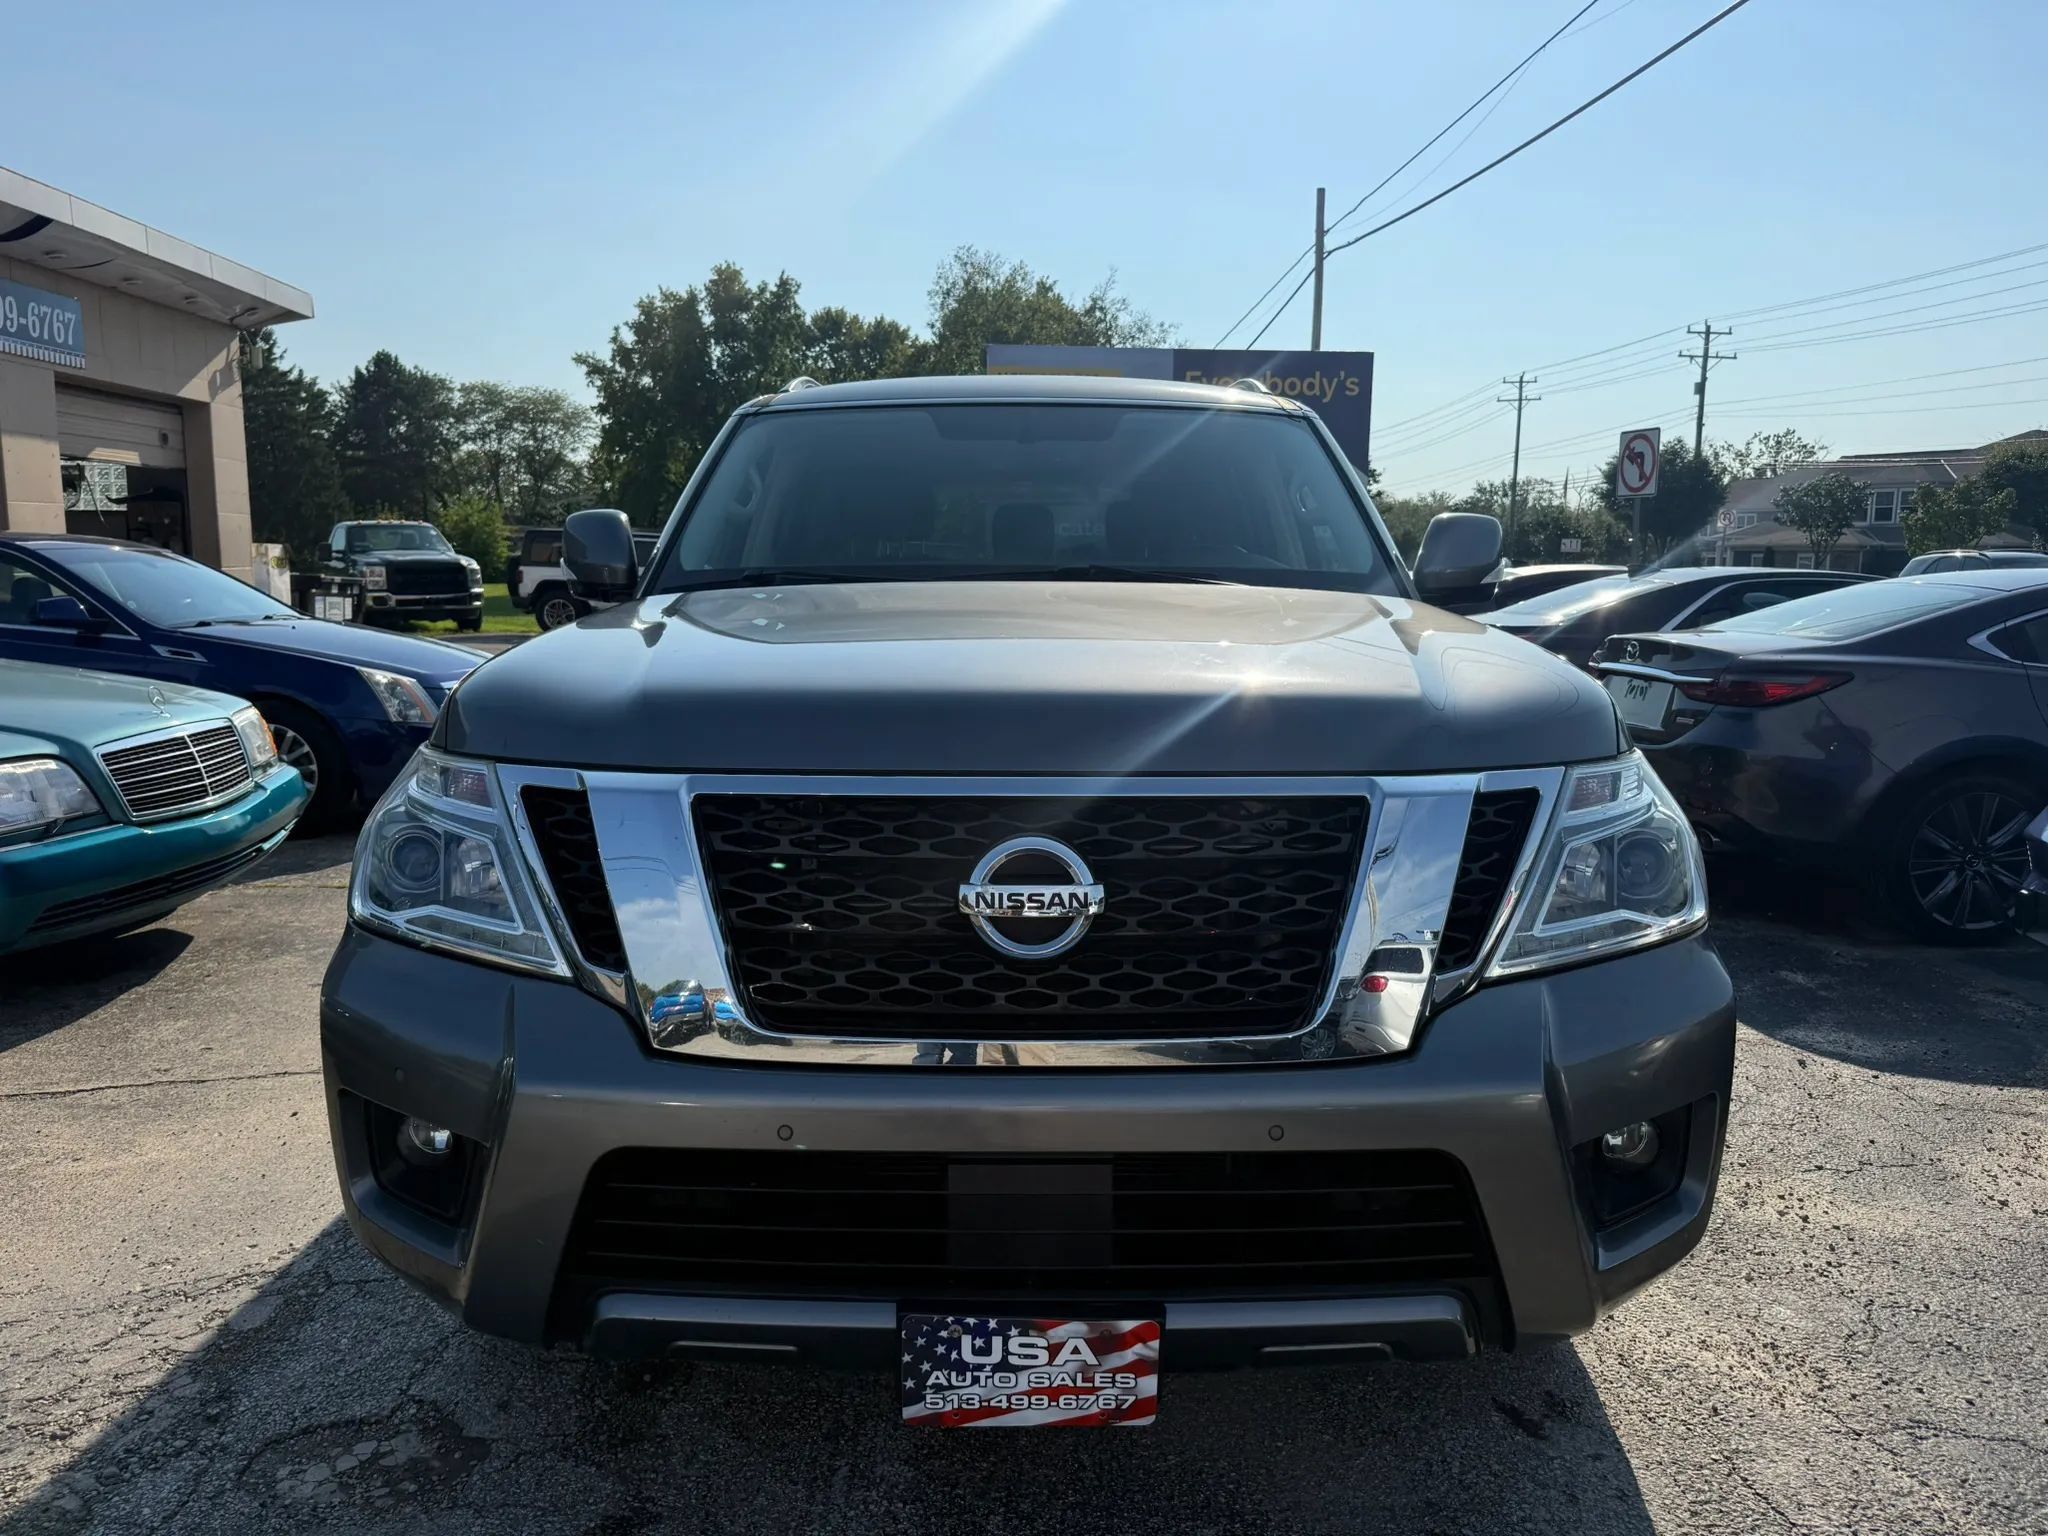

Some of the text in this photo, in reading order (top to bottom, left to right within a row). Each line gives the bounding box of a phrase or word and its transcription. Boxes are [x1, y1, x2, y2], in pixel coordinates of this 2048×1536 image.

[1187, 371, 1360, 402] Ebody's
[975, 892, 1088, 910] NISSAN
[961, 1335, 1100, 1366] USA
[926, 1372, 1137, 1388] AUTO SALES
[925, 1393, 1137, 1409] 513-499-6767
